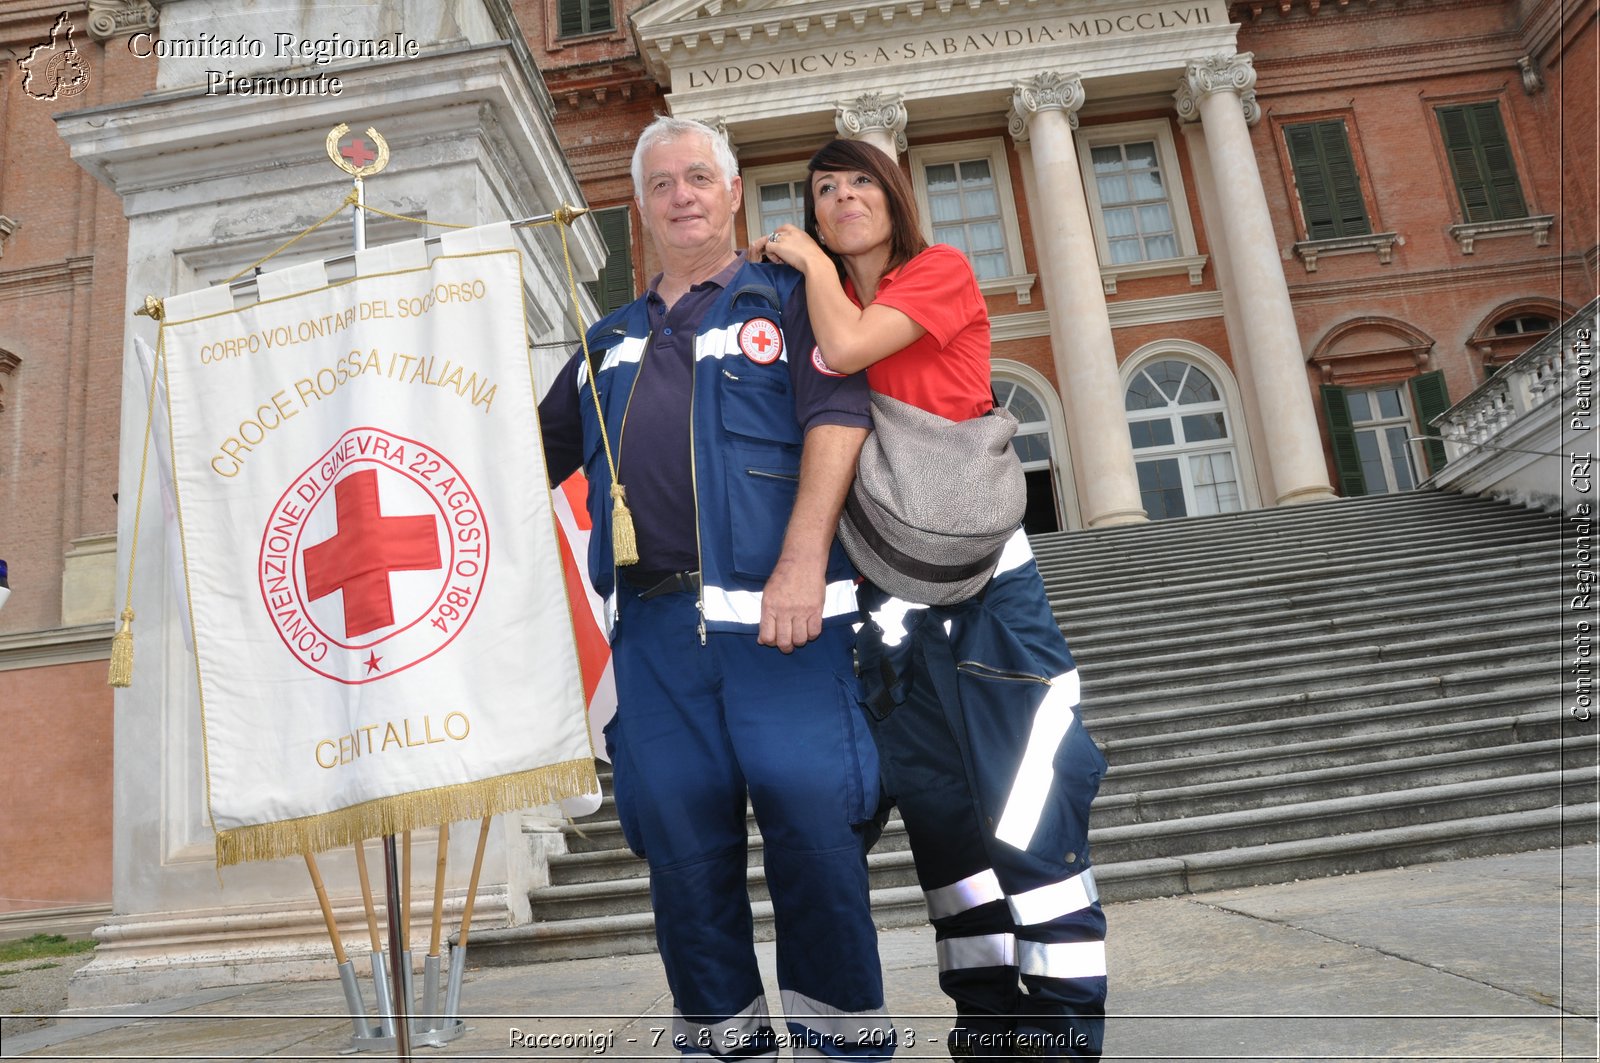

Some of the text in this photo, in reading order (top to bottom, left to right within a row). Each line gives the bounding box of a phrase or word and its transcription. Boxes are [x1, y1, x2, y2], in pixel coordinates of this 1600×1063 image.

[200, 279, 486, 365] CORPO VOLONTARI DEL SOCCORSO
[211, 349, 498, 479] CROCE ROSSA ITALIANA
[264, 435, 481, 663] CONVENZIONE DI GINEVRA 22 AGOSTO 1864
[315, 710, 470, 769] CENTALLO
